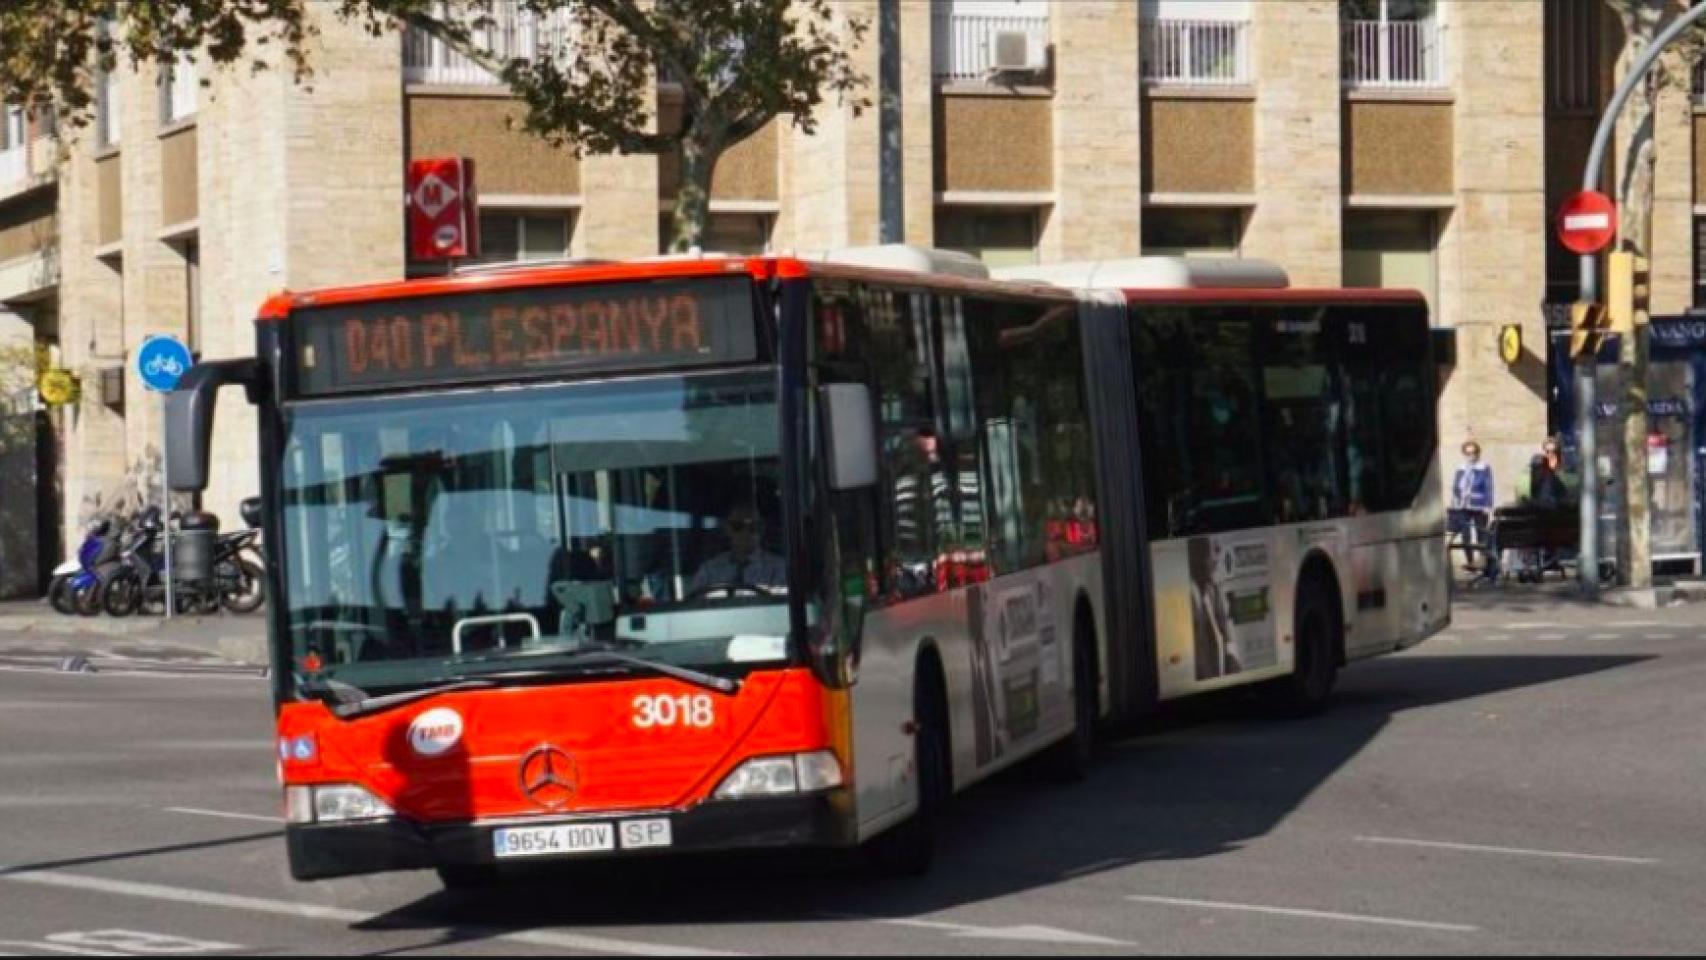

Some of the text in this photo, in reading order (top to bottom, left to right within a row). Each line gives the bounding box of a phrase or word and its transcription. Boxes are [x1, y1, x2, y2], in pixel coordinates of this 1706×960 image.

[423, 184, 442, 207] M
[632, 694, 714, 728] 3018
[507, 829, 560, 851] 9654
[625, 823, 664, 844] SP
